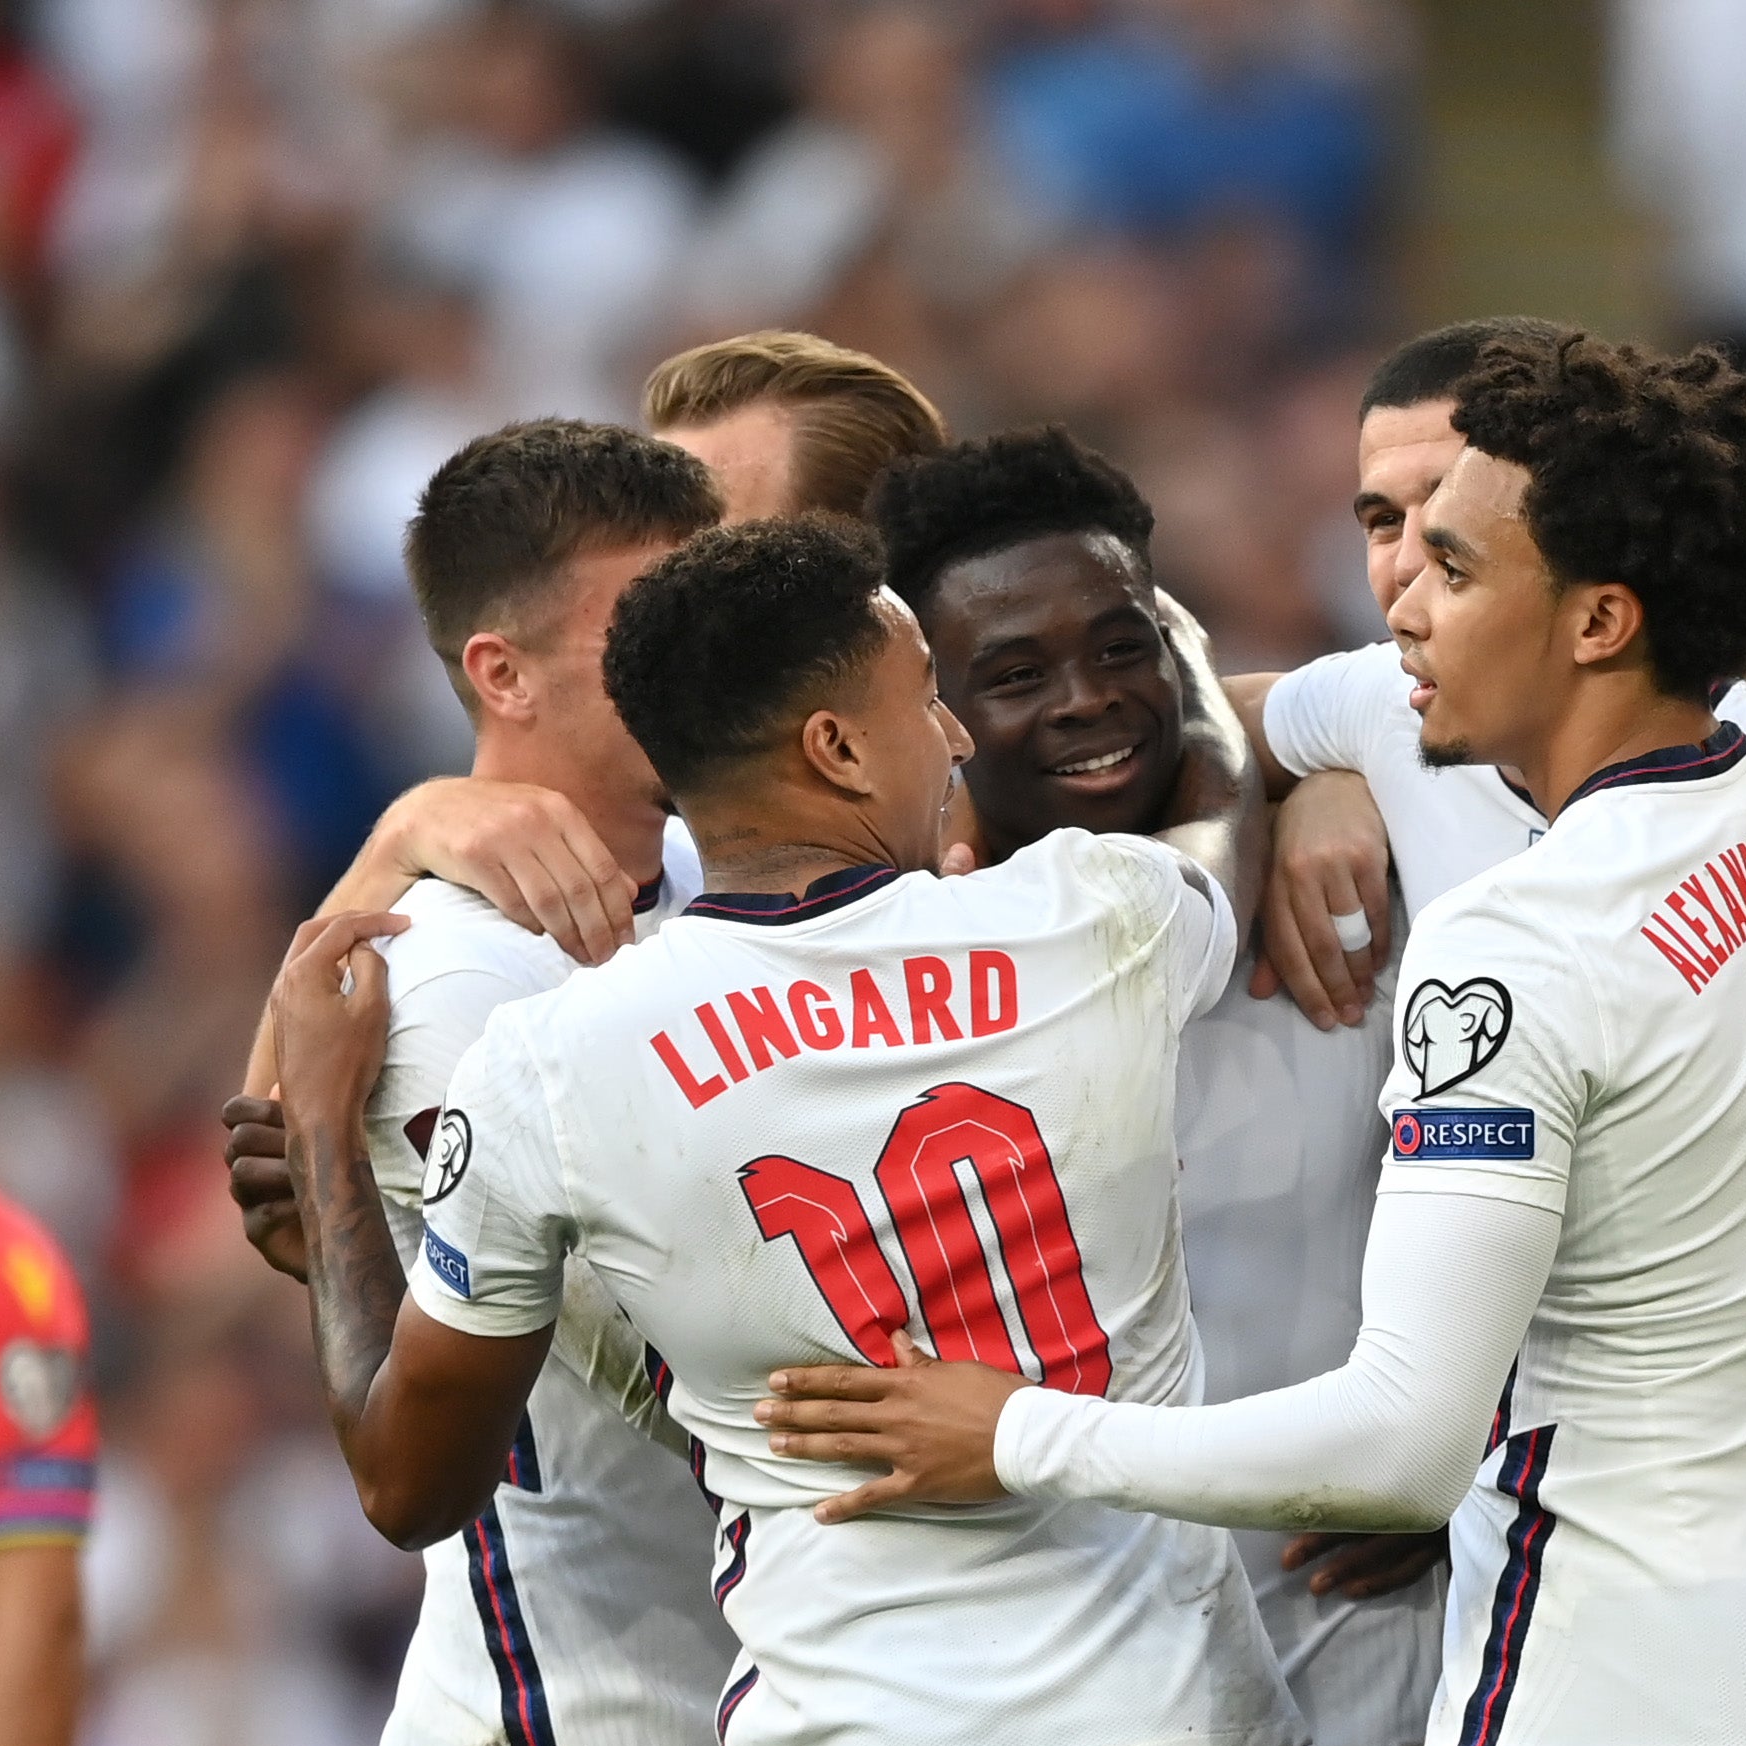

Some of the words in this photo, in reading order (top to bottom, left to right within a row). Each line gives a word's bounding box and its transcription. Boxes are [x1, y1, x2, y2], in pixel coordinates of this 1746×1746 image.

[649, 949, 1020, 1111] LINGARD
[1423, 1123, 1532, 1146] RESPECT
[423, 1229, 467, 1284] SPECT
[736, 1080, 1114, 1400] 10
